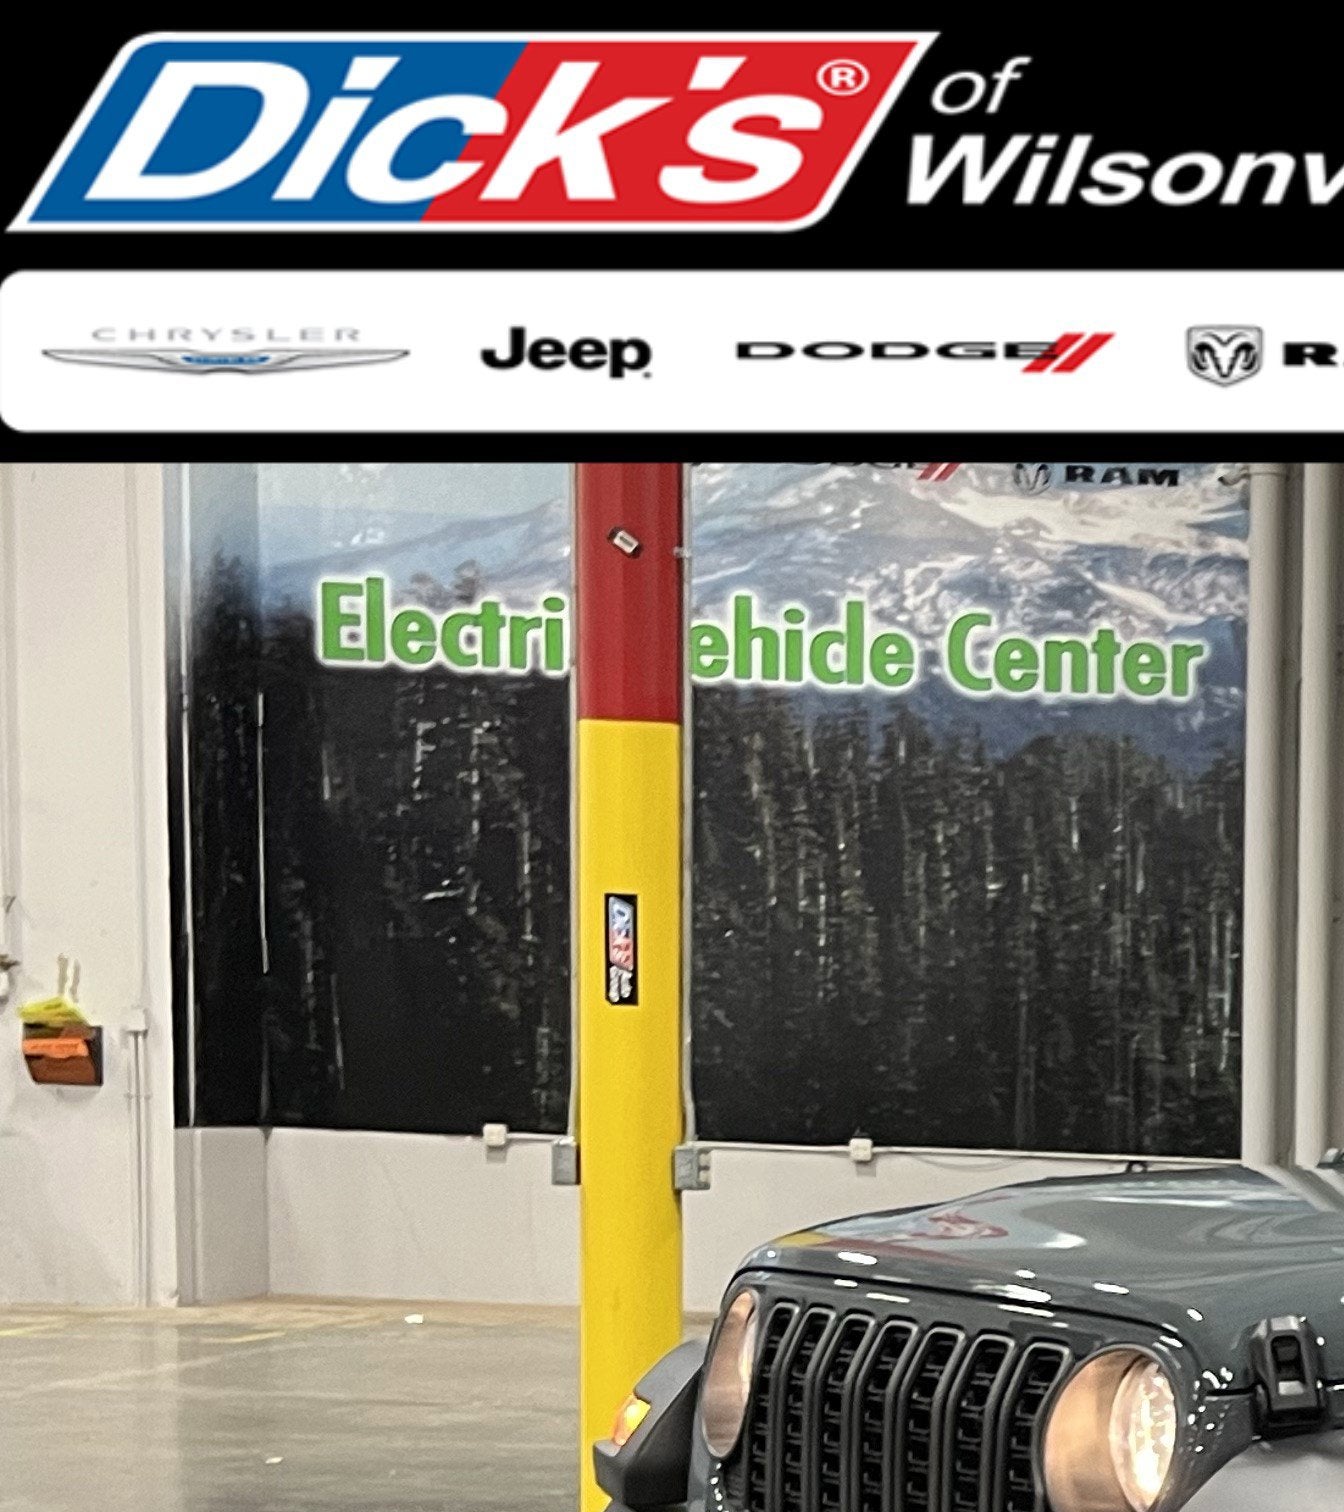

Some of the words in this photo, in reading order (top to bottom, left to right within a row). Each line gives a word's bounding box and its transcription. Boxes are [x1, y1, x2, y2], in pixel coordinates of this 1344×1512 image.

[1064, 464, 1180, 487] RAM
[321, 577, 565, 672] Electri
[690, 594, 915, 686] ehicle
[948, 612, 1202, 697] Center
